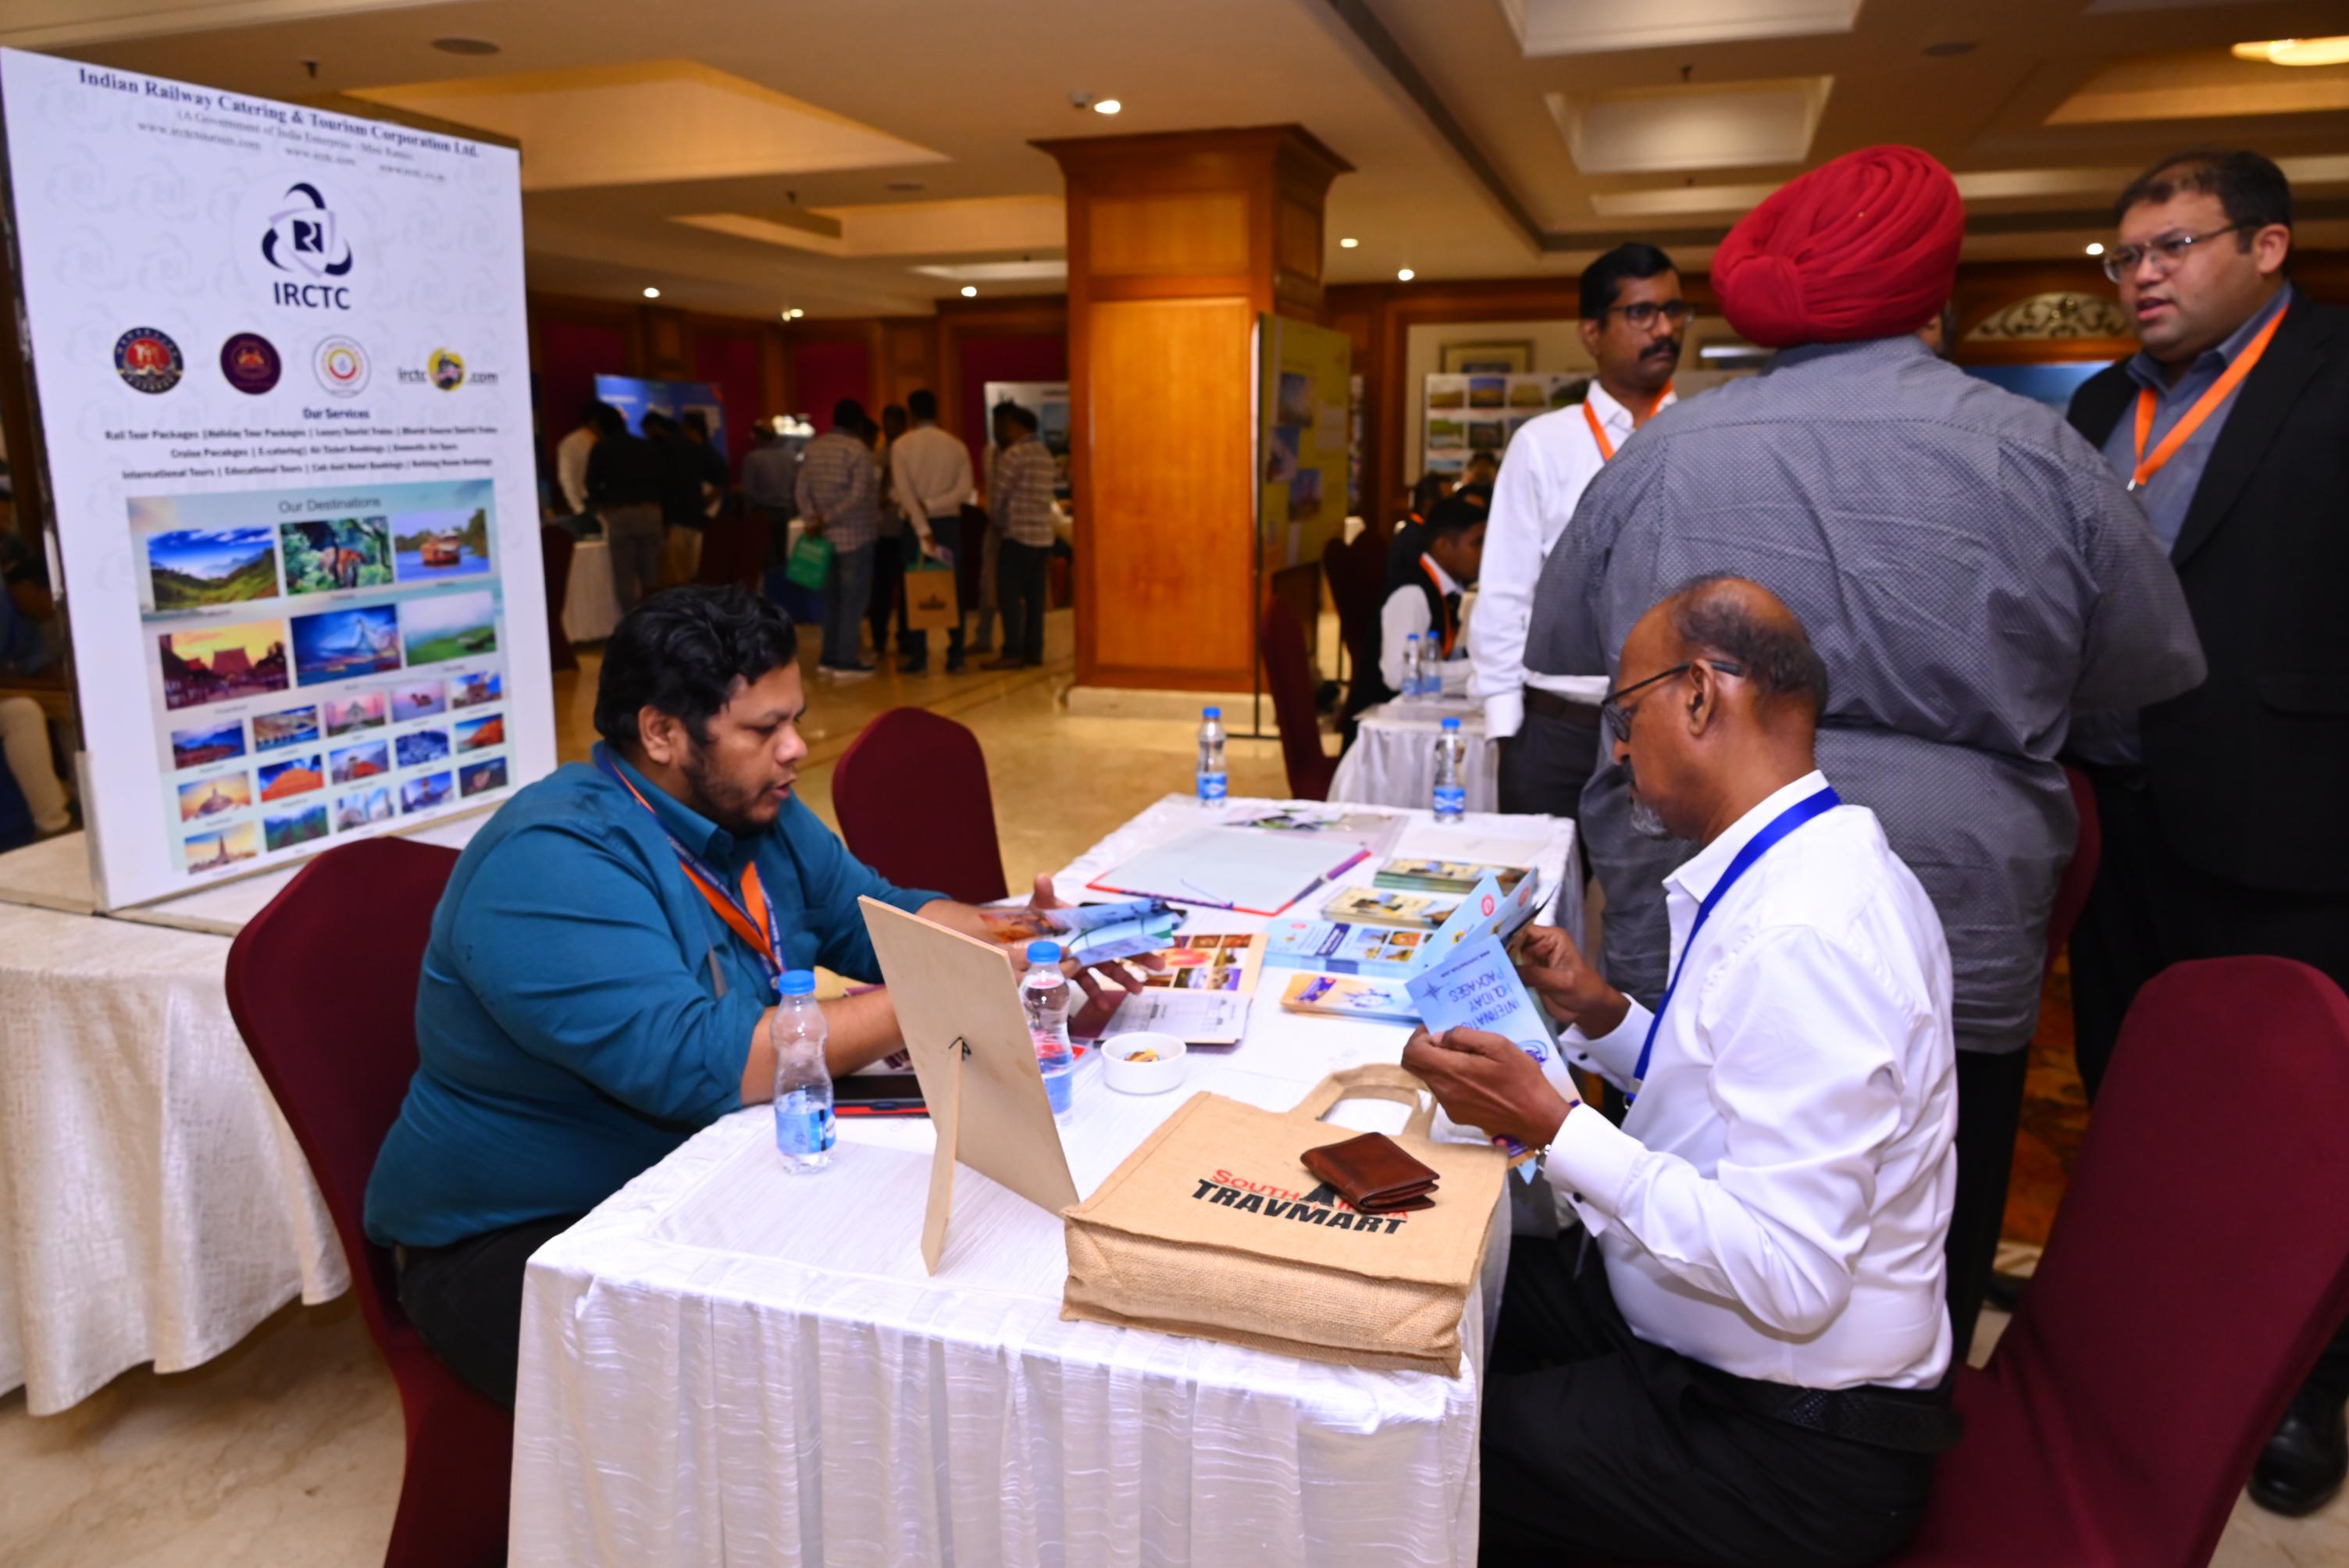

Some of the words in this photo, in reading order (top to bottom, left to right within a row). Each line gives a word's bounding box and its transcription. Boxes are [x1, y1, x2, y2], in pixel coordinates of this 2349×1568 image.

[80, 68, 139, 93] Indian
[145, 80, 212, 109] Railway
[219, 95, 287, 123] Catering
[291, 110, 305, 124] &
[311, 113, 368, 136] Tourism
[372, 126, 451, 151] Corporation
[454, 141, 480, 158] Ltd.
[273, 280, 351, 310] IRCTC
[303, 408, 323, 419] Our
[326, 408, 370, 419] Services
[105, 430, 126, 440] Rail
[128, 429, 148, 440] Tour
[151, 429, 199, 441] Packages
[265, 428, 306, 439] Packages
[122, 468, 187, 479] International
[190, 467, 216, 477] Tours
[224, 465, 279, 476] Educational
[279, 499, 303, 514] Our
[306, 496, 382, 512] Destinations
[1448, 967, 1504, 1003] PACKAGES
[1469, 982, 1513, 1013] HOLIDAY
[1461, 999, 1521, 1030] INTERNATI
[1212, 1168, 1301, 1201] SOUTH
[1192, 1178, 1408, 1235] TRAVMART
